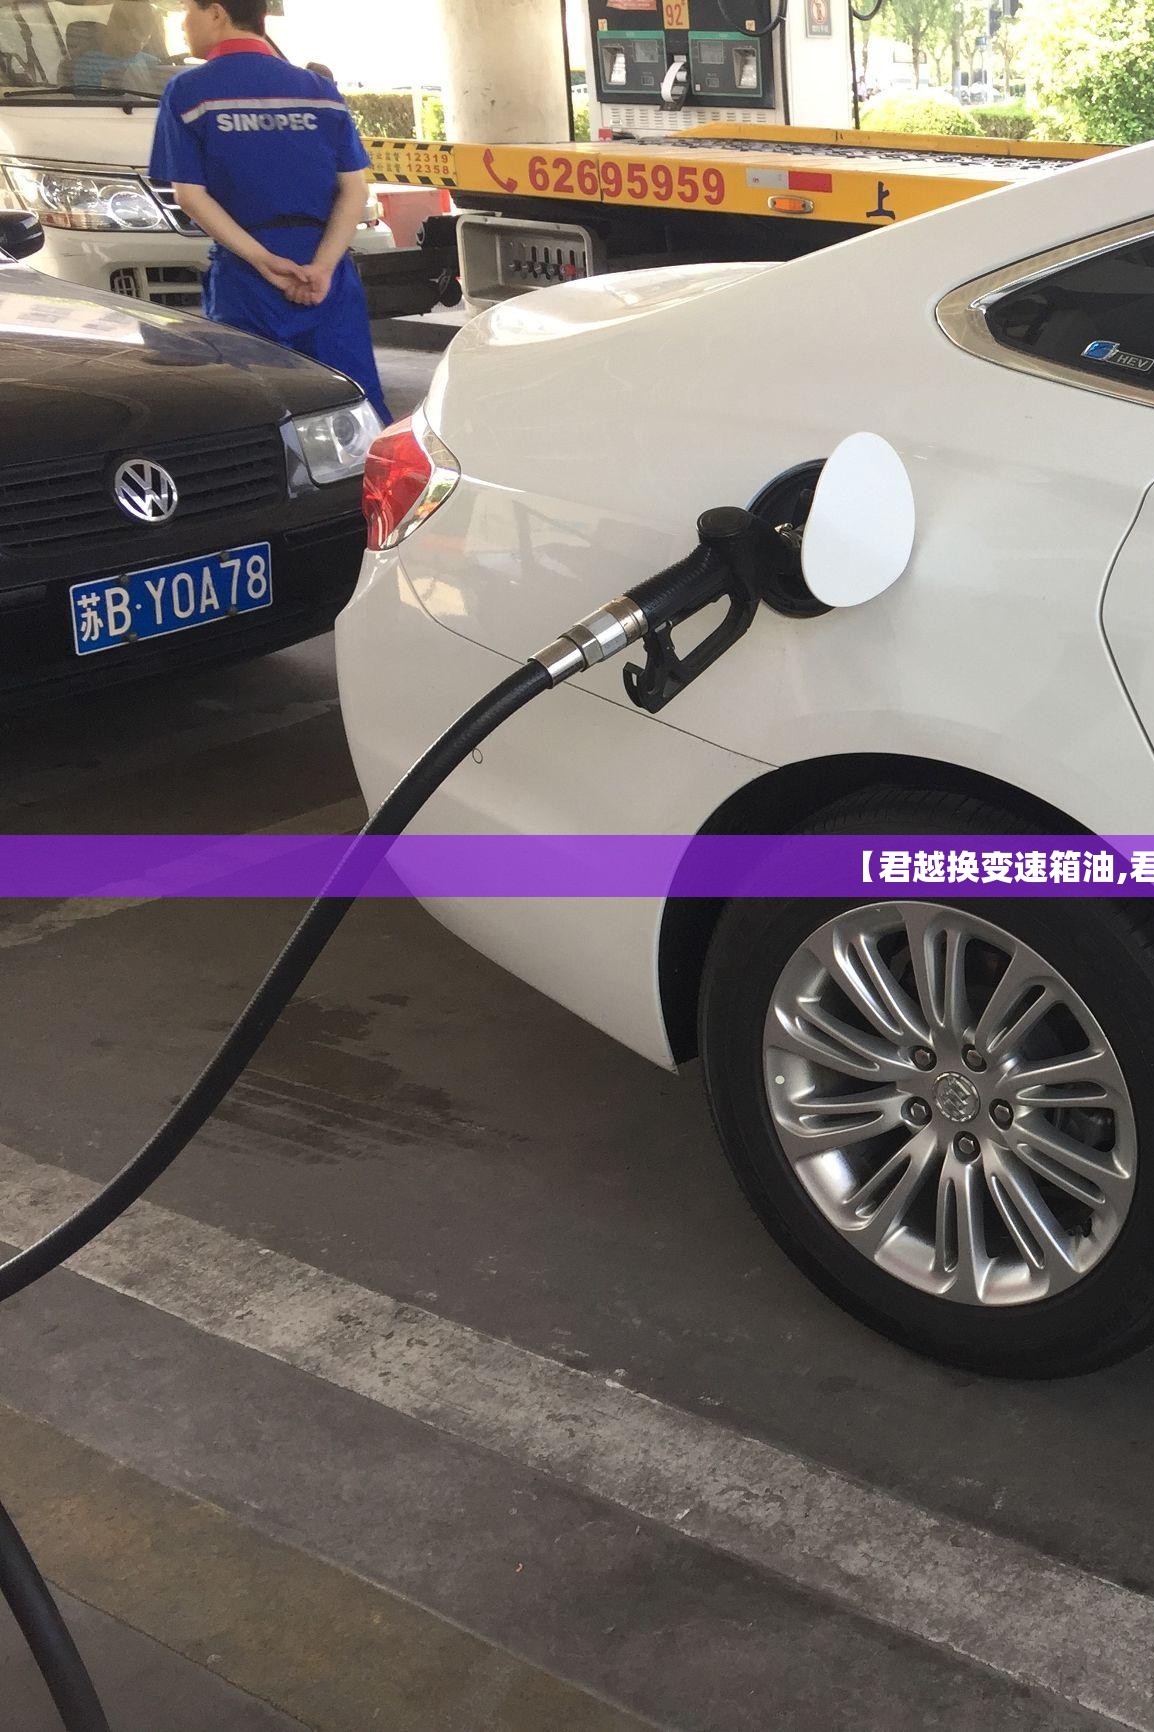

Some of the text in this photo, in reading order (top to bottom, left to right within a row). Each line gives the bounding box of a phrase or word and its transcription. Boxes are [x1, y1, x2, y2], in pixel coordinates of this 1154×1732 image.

[666, 4, 684, 26] 92
[216, 112, 318, 132] SINOPEC
[406, 151, 449, 164] 12319
[407, 164, 450, 175] 12358
[528, 156, 725, 205] 62695959
[1116, 354, 1149, 368] HEV
